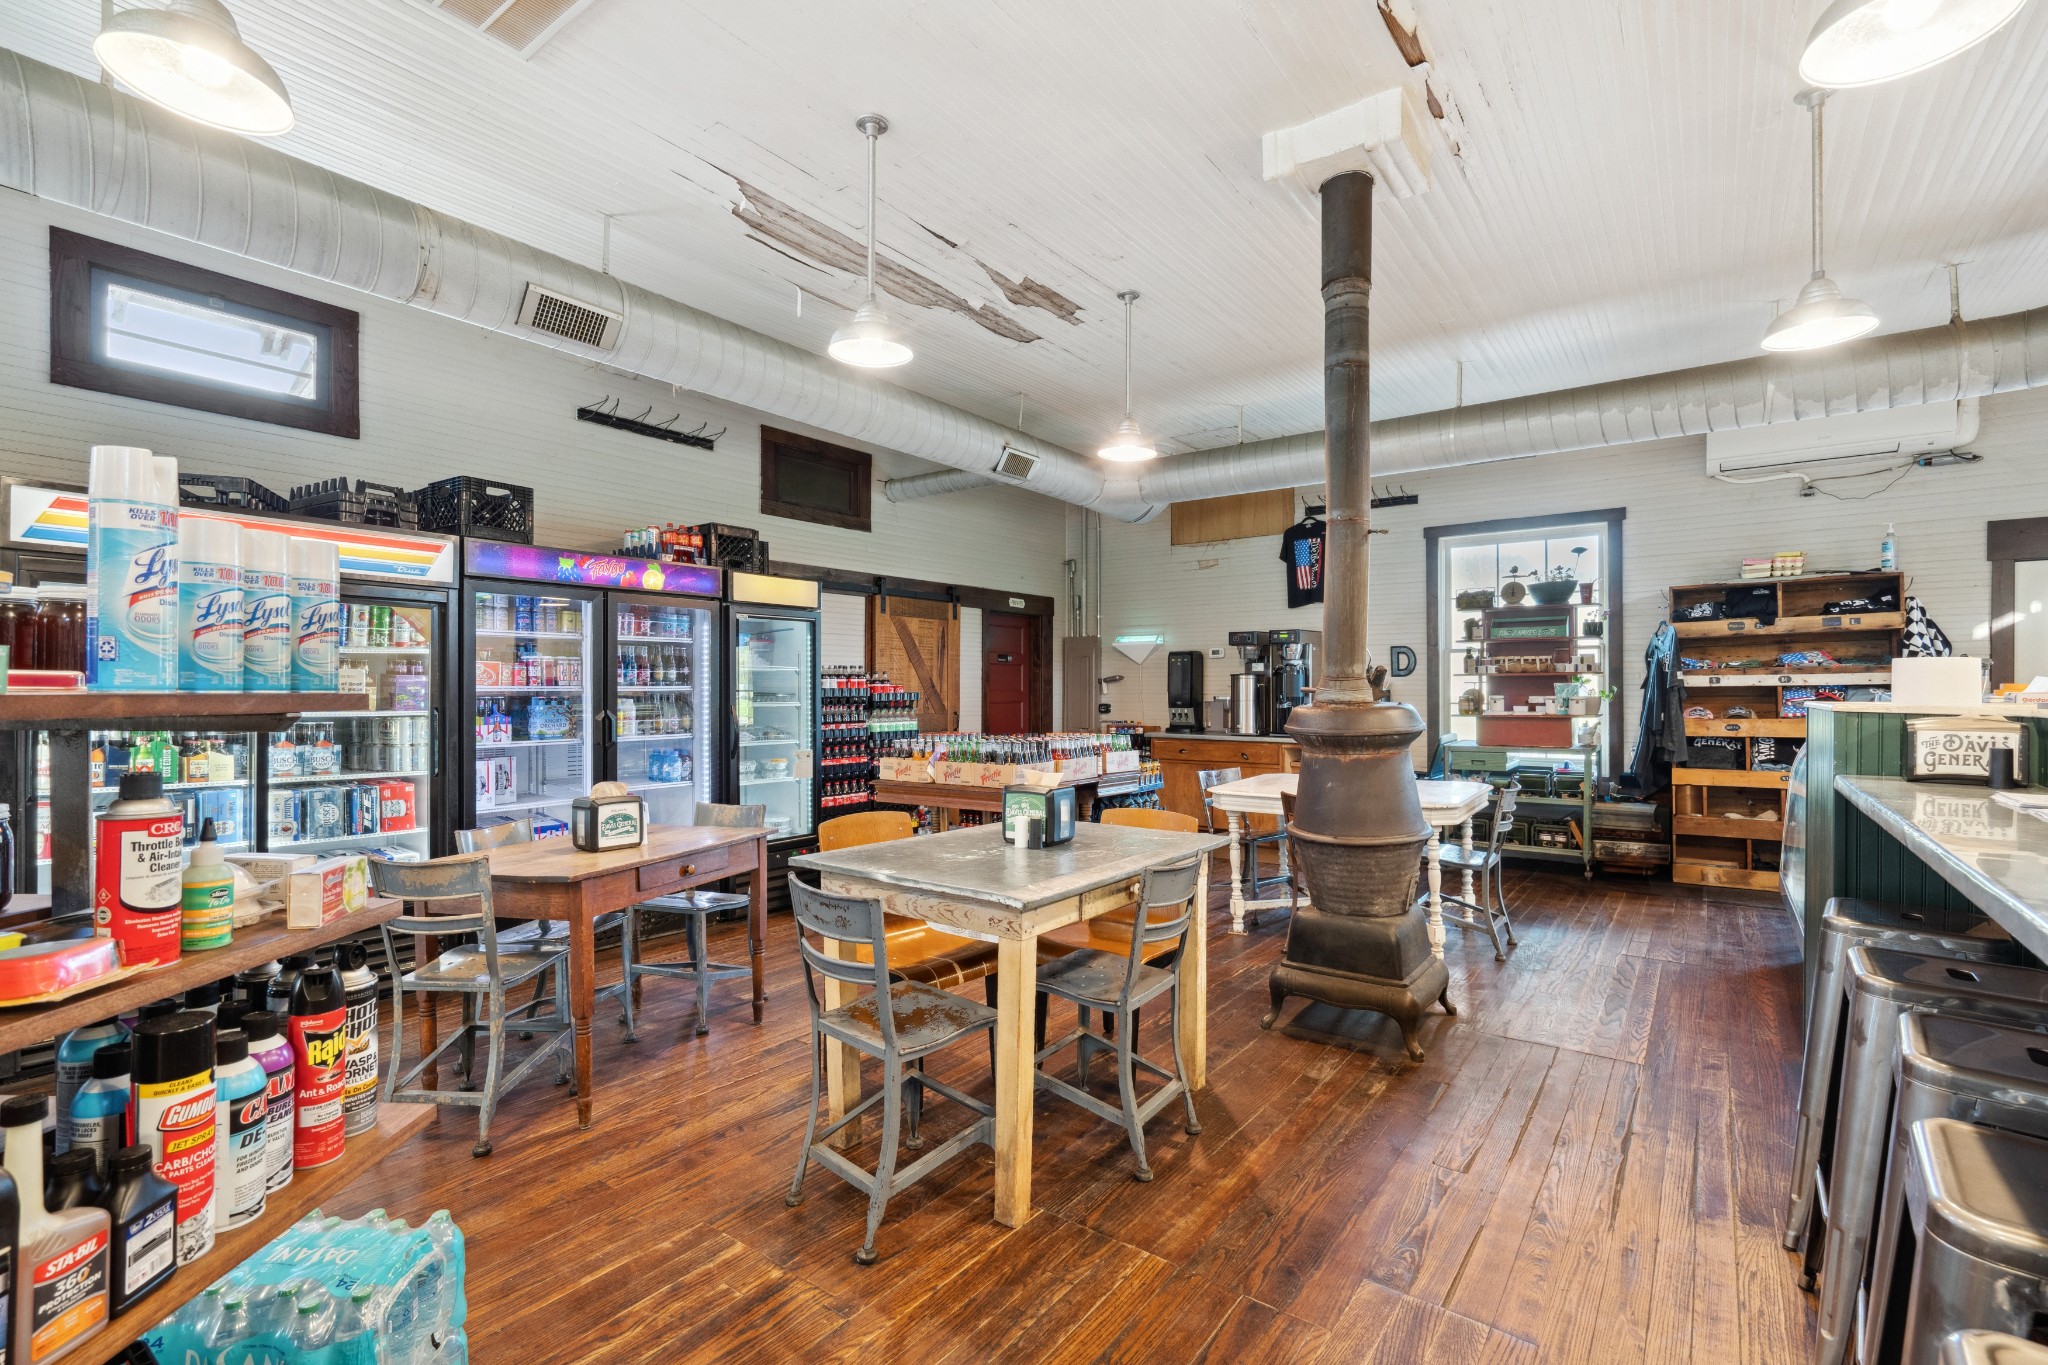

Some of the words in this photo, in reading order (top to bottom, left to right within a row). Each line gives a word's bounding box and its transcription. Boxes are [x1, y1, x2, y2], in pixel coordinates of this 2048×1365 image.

[129, 507, 157, 516] KILLS
[130, 513, 156, 521] OVER
[589, 559, 625, 577] Faygo
[134, 615, 161, 623] ODORS
[244, 600, 291, 627] Lysol
[1391, 645, 1417, 677] D
[1922, 738, 1940, 750] THE
[1943, 734, 2010, 752] DAVIS
[272, 756, 298, 765] BUSCH
[311, 756, 336, 764] BUSCH
[1923, 751, 1989, 772] GENER
[151, 821, 181, 835] CRC
[131, 840, 173, 852] Throttle
[137, 853, 145, 863] &
[150, 862, 180, 873] Cleaner
[208, 899, 219, 908] To
[219, 897, 231, 905] Go
[308, 1025, 346, 1067] Raid
[345, 1059, 377, 1080] ORNET
[169, 1079, 193, 1089] CLEANS
[353, 1084, 361, 1094] On
[153, 1087, 179, 1096] QUICKLY
[300, 1088, 318, 1098] Ant
[318, 1088, 325, 1096] &
[172, 1139, 189, 1151] JET
[191, 1129, 213, 1145] SPRAY
[236, 1154, 248, 1162] FOR
[236, 1156, 257, 1168] FROZEN
[169, 1166, 194, 1178] PARTS
[236, 1166, 249, 1174] AND
[144, 1212, 154, 1227] 2
[45, 1237, 98, 1278] STA-BIL
[38, 1271, 102, 1315] PROTECTION
